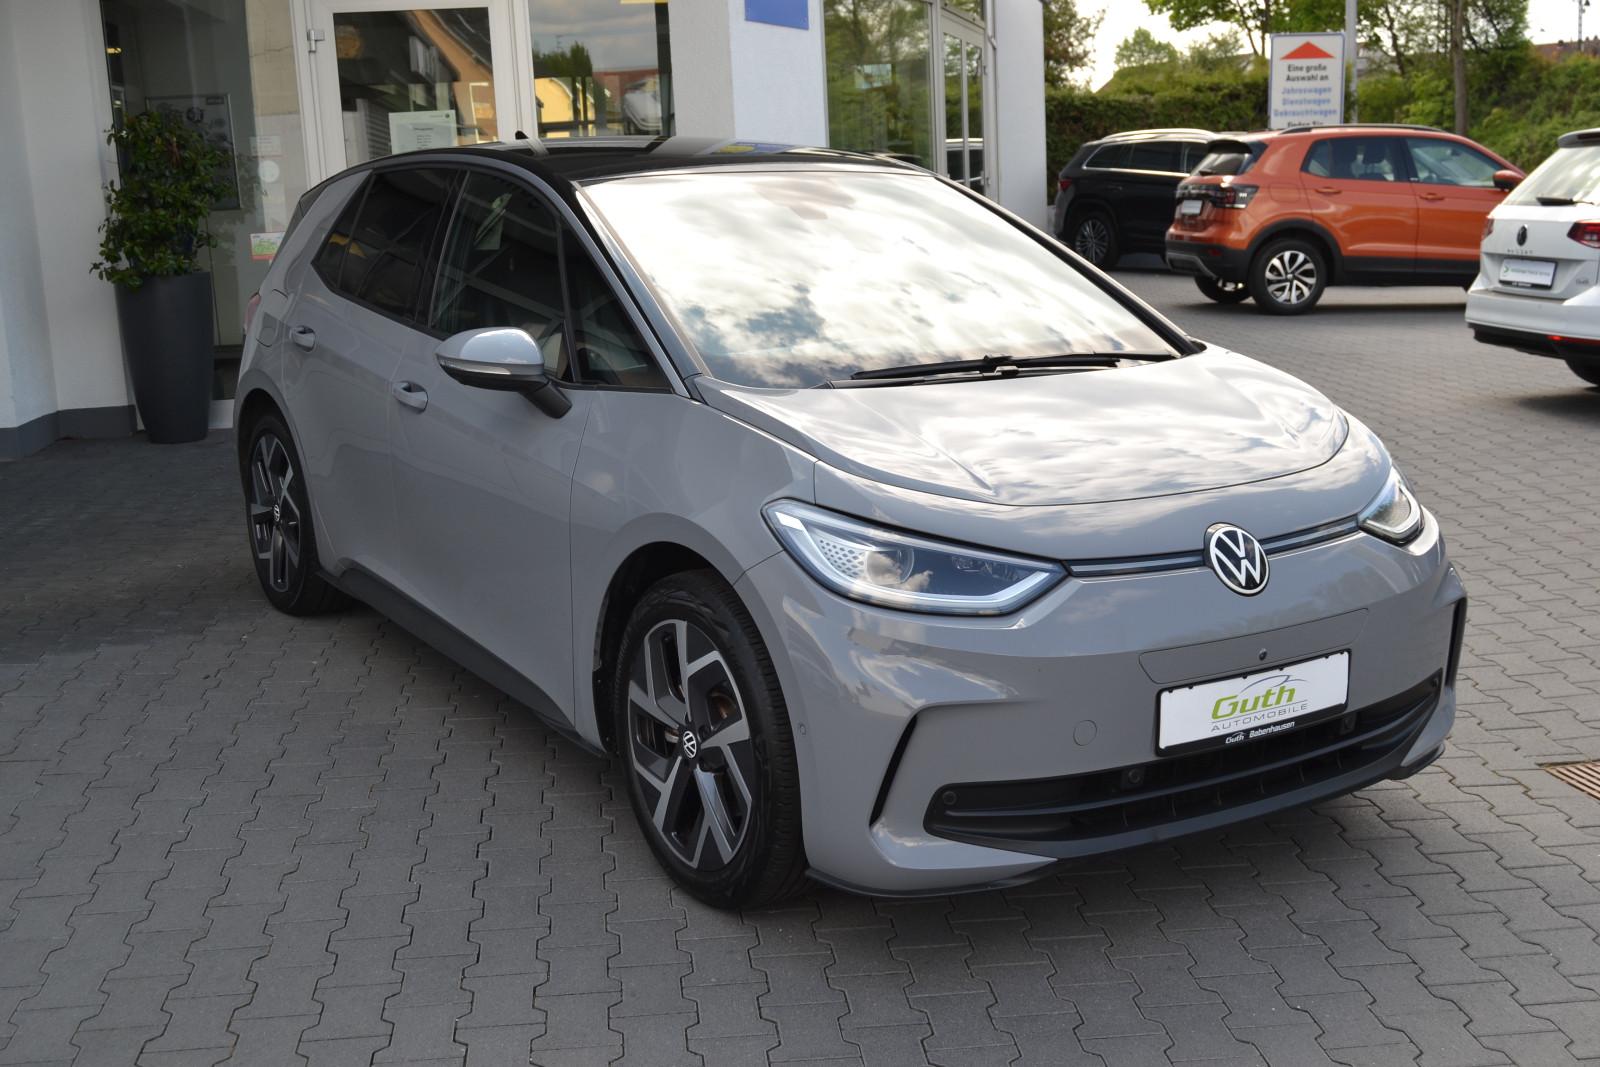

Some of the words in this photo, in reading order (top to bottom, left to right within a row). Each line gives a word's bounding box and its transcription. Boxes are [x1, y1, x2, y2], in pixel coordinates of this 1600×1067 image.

[1286, 74, 1318, 82] Auswahl
[1287, 64, 1304, 72] Eine
[1305, 64, 1327, 73] große
[1211, 685, 1296, 720] Guth
[1211, 702, 1309, 733] AUTOMOBILE
[1225, 734, 1245, 744] Guth
[1248, 721, 1296, 738] Babenhausen
